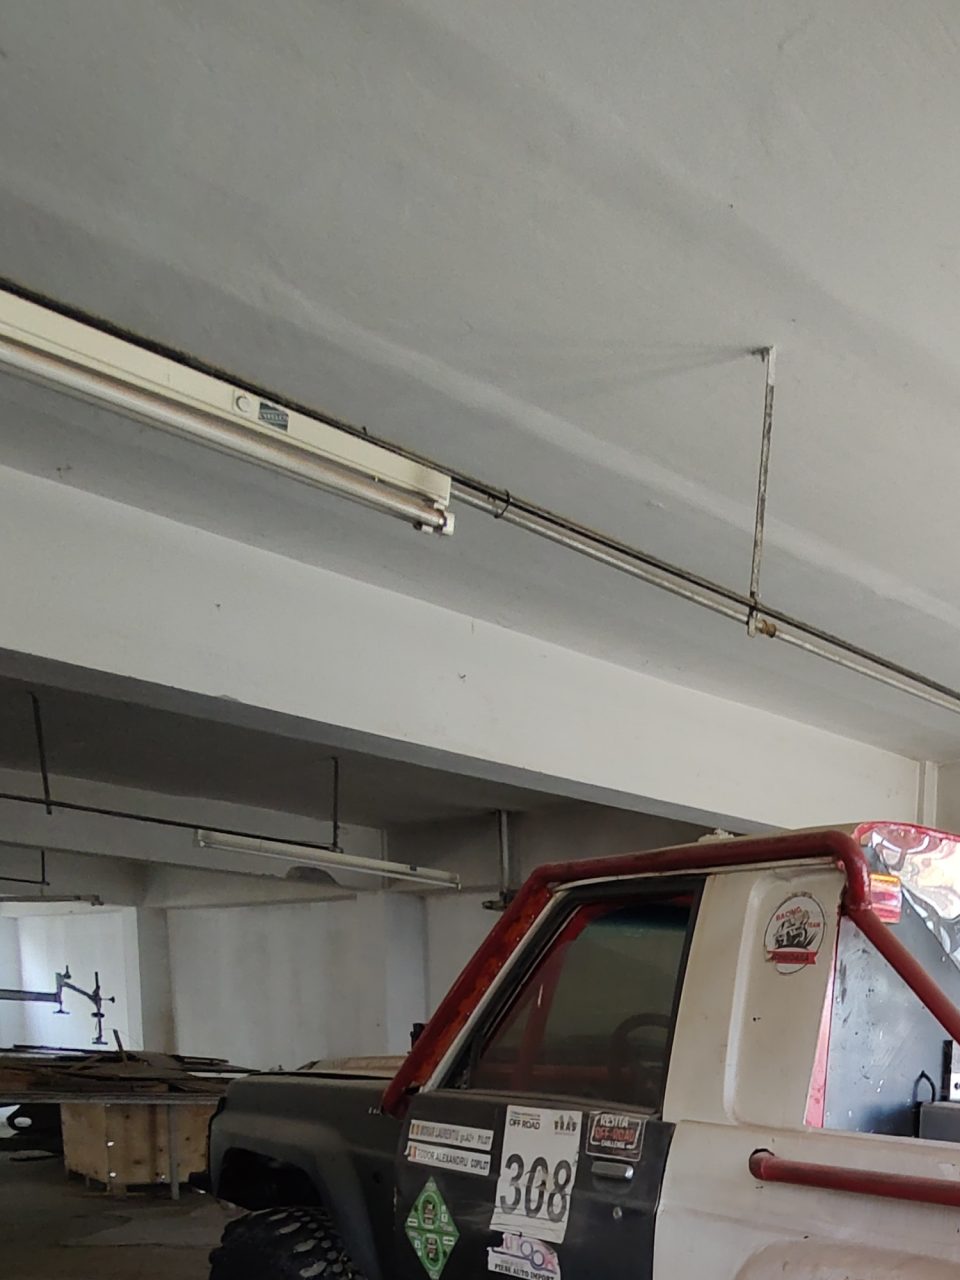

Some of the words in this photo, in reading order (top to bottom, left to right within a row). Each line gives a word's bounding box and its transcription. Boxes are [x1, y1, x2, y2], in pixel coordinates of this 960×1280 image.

[776, 906, 801, 921] RACING
[508, 1118, 521, 1128] OFF
[521, 1119, 541, 1130] ROAD
[435, 1151, 469, 1167] ALEXANDRU
[471, 1158, 489, 1171] COPILOT
[500, 1153, 572, 1223] 308
[513, 1267, 530, 1278] AUTO
